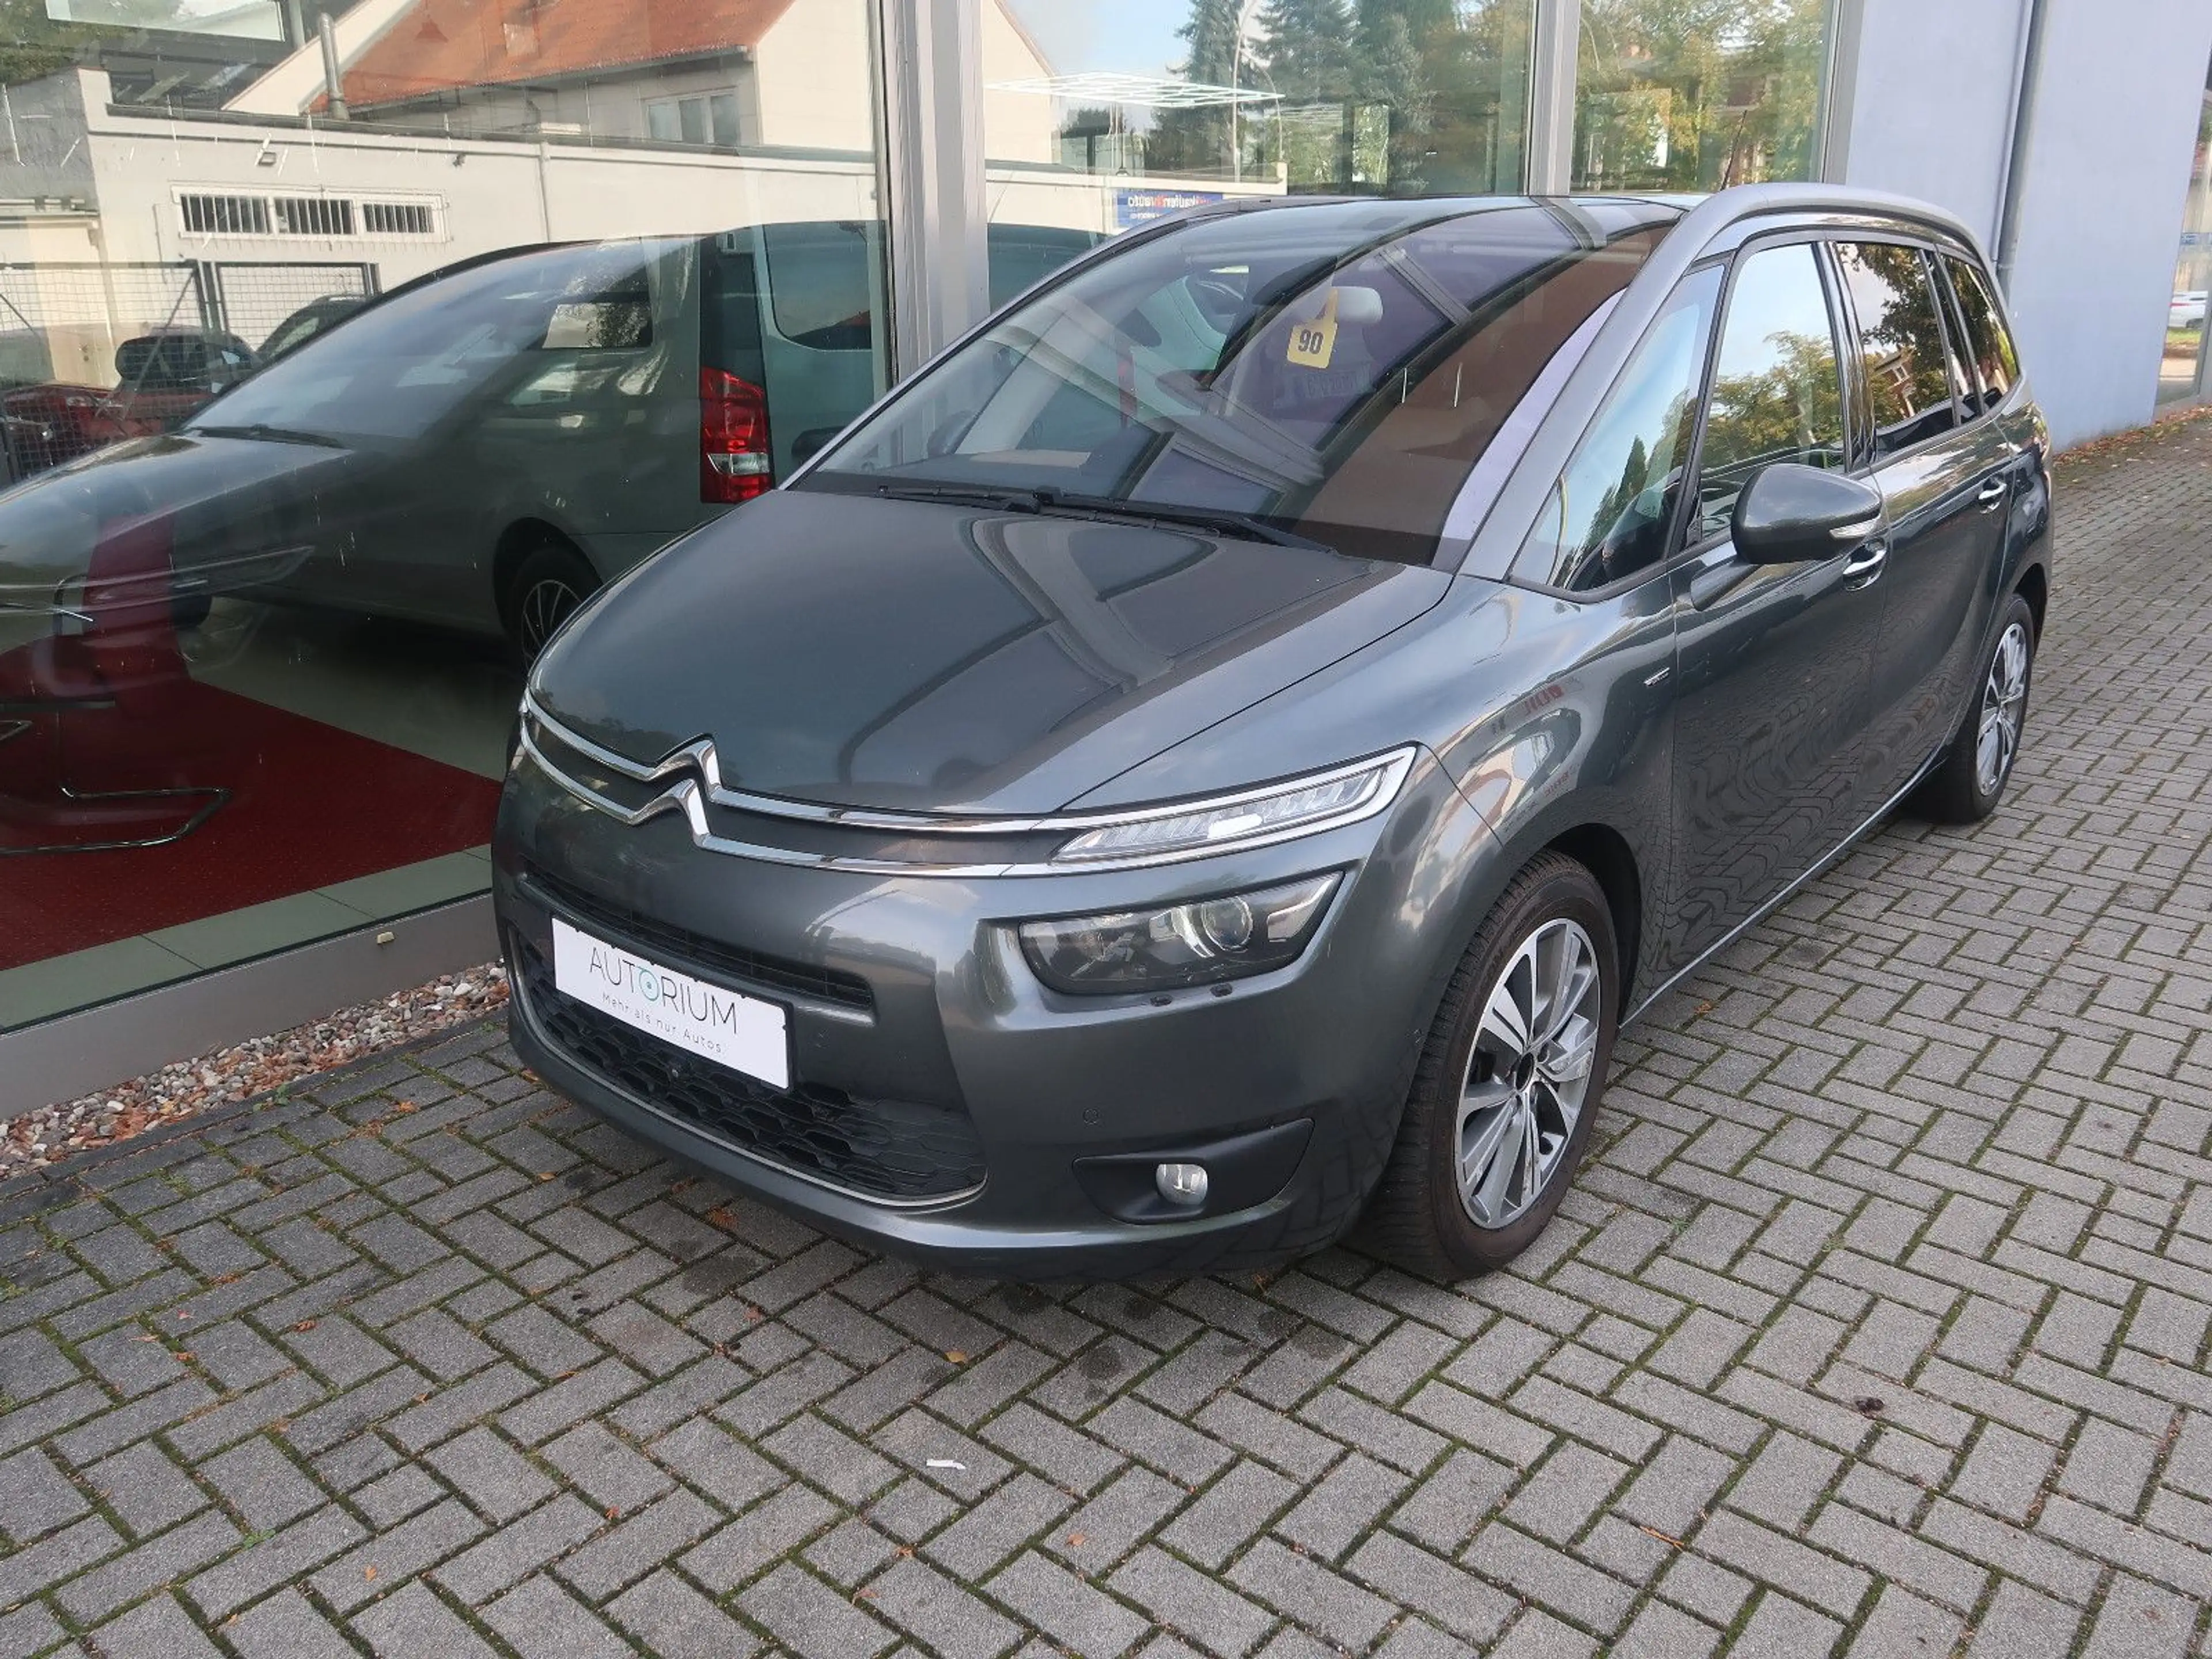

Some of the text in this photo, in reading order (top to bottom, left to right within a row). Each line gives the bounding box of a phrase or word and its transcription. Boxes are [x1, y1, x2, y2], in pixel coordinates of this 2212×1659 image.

[1298, 329, 1324, 354] 90
[589, 947, 737, 1034] AUTORIUM
[603, 993, 722, 1053] Mehr als nur Autos
